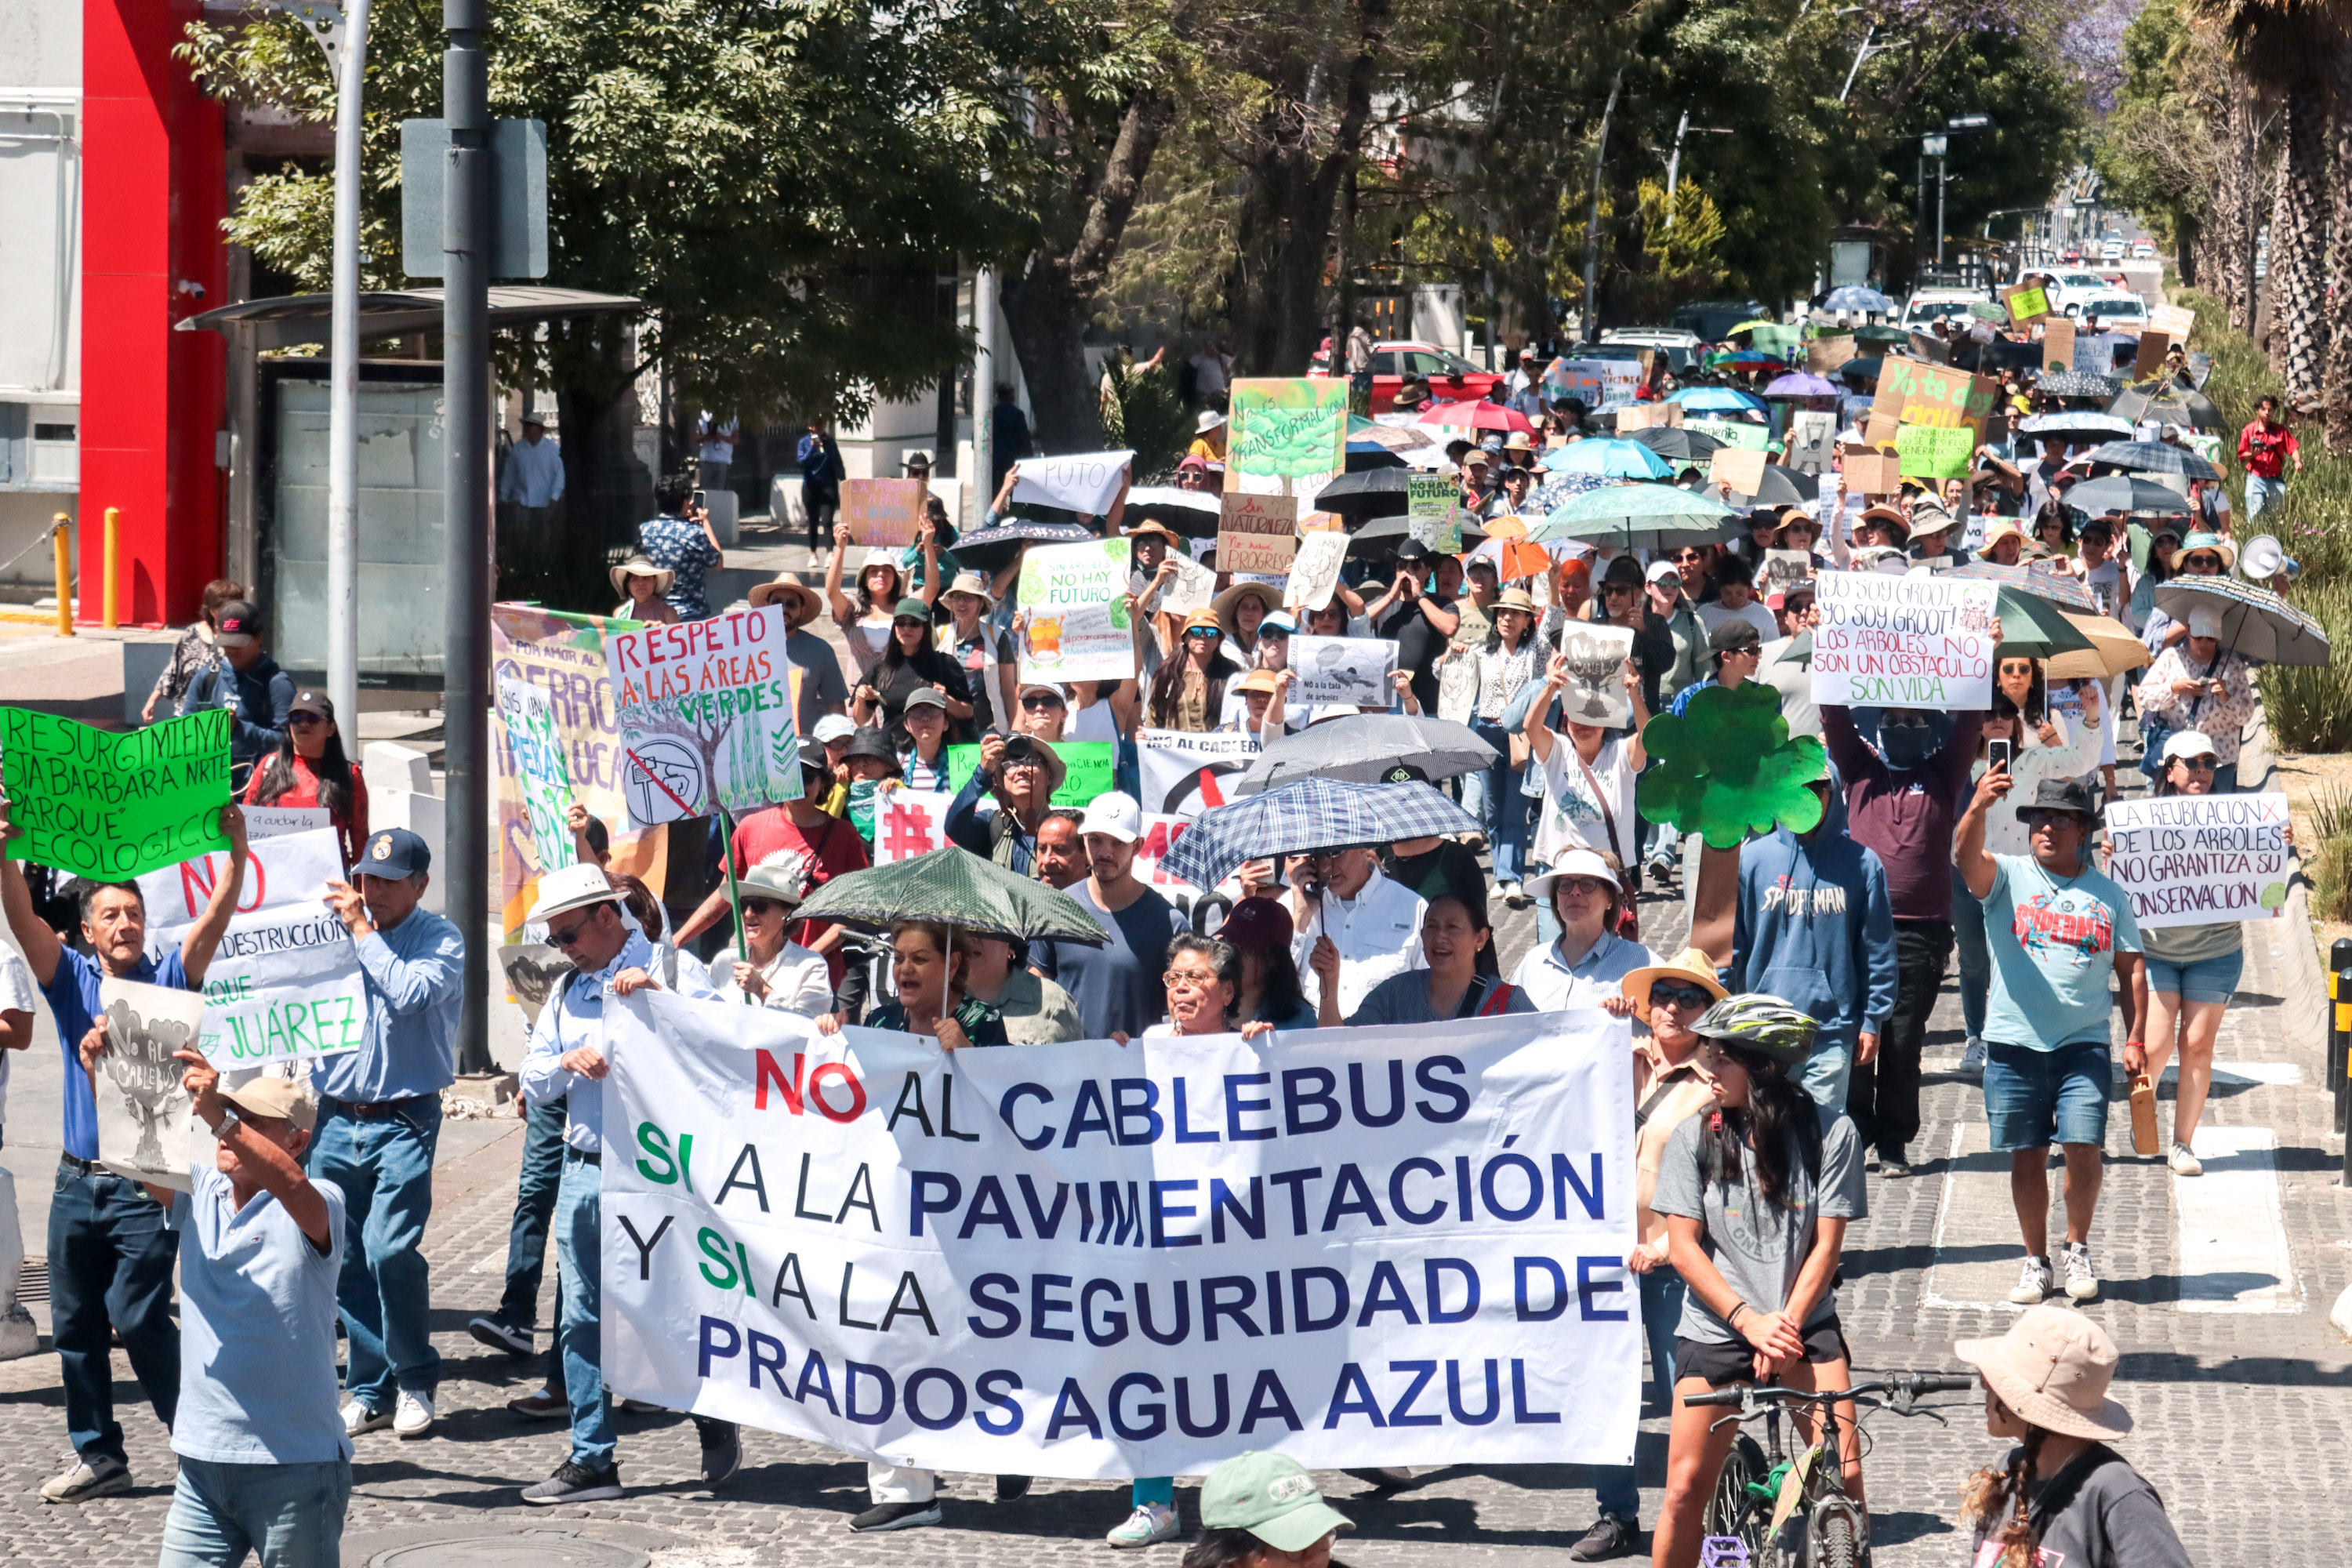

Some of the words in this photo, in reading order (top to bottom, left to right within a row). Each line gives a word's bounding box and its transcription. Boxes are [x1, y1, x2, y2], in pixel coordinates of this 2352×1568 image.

[1888, 362, 1917, 397] Yo
[1922, 368, 1947, 401] te
[1951, 376, 1994, 417] doy
[1228, 397, 1348, 464] TRANSFORMACION
[1915, 437, 1924, 445] SE
[1929, 437, 1969, 447] RESUELVE
[1916, 429, 1962, 437] PROBLEMA
[1898, 446, 1948, 455] GENERANDO
[1950, 447, 1971, 456] OTRO
[1044, 461, 1106, 488] PUTO
[1929, 459, 1937, 472] Y
[1410, 488, 1459, 499] FUTURO
[1428, 481, 1450, 490] HAY
[1220, 514, 1294, 536] NATURALEZA
[1228, 535, 1242, 548] No
[1049, 563, 1065, 572] SIN
[1226, 550, 1294, 572] PROGRESO
[1051, 574, 1076, 586] NO
[1082, 571, 1111, 584] HAY
[1050, 587, 1111, 604] FUTURO
[1857, 579, 1892, 601] SOY
[1896, 580, 1958, 607] GROOT,
[1822, 602, 1846, 625] YO
[1852, 604, 1887, 630] SOY
[1893, 607, 1957, 636] GROOT!
[516, 640, 541, 659] POR
[543, 644, 577, 665] AMOR
[582, 653, 599, 667] AL
[616, 611, 767, 673] RESPETO
[1816, 630, 1849, 650] LOS
[1856, 628, 1928, 655] ÁRBOLES
[1944, 636, 1979, 659] NO
[622, 676, 640, 707] A
[644, 664, 691, 702] LAS
[699, 649, 772, 691] ÁREAS
[1815, 654, 1849, 672] SON
[1857, 655, 1884, 675] UN
[1889, 655, 1988, 679] OBSTÁCULO
[1315, 693, 1339, 702] árboles
[1328, 681, 1341, 690] tala
[1850, 675, 1894, 701] SON
[1899, 677, 1946, 702] VIDA
[677, 680, 784, 724] VERDES
[1177, 739, 1196, 750] AL
[186, 752, 230, 787] NRTE
[2110, 805, 2143, 827] LA
[2150, 799, 2262, 827] REUBICACIÓN
[31, 807, 223, 874] ECOLOGICO
[2112, 830, 2142, 854] DE
[2151, 829, 2186, 851] LOS
[2194, 826, 2282, 851] ÁRBOLES
[2111, 857, 2146, 884] NO
[2148, 853, 2252, 884] GARANTIZA
[2257, 854, 2281, 874] SU
[225, 996, 361, 1059] JUÁREZ
[147, 1039, 168, 1064] AL
[116, 1060, 176, 1094] CABLEBUS
[753, 1047, 867, 1124] NO
[887, 1070, 980, 1143] AL
[998, 1054, 1470, 1151] CABLEBUS
[635, 1120, 695, 1195] SI
[713, 1143, 771, 1214] A
[794, 1152, 883, 1232] LA
[909, 1134, 1605, 1248] PAVIMENTACIÓN
[616, 1214, 675, 1282] Y
[696, 1225, 757, 1298] SI
[771, 1252, 818, 1322] A
[839, 1261, 940, 1337] LA
[967, 1256, 1481, 1348] SEGURIDAD
[1512, 1255, 1630, 1324] DE
[696, 1314, 1025, 1436] PRADOS
[1044, 1368, 1305, 1442] AGUA
[1322, 1357, 1563, 1430] AZUL
